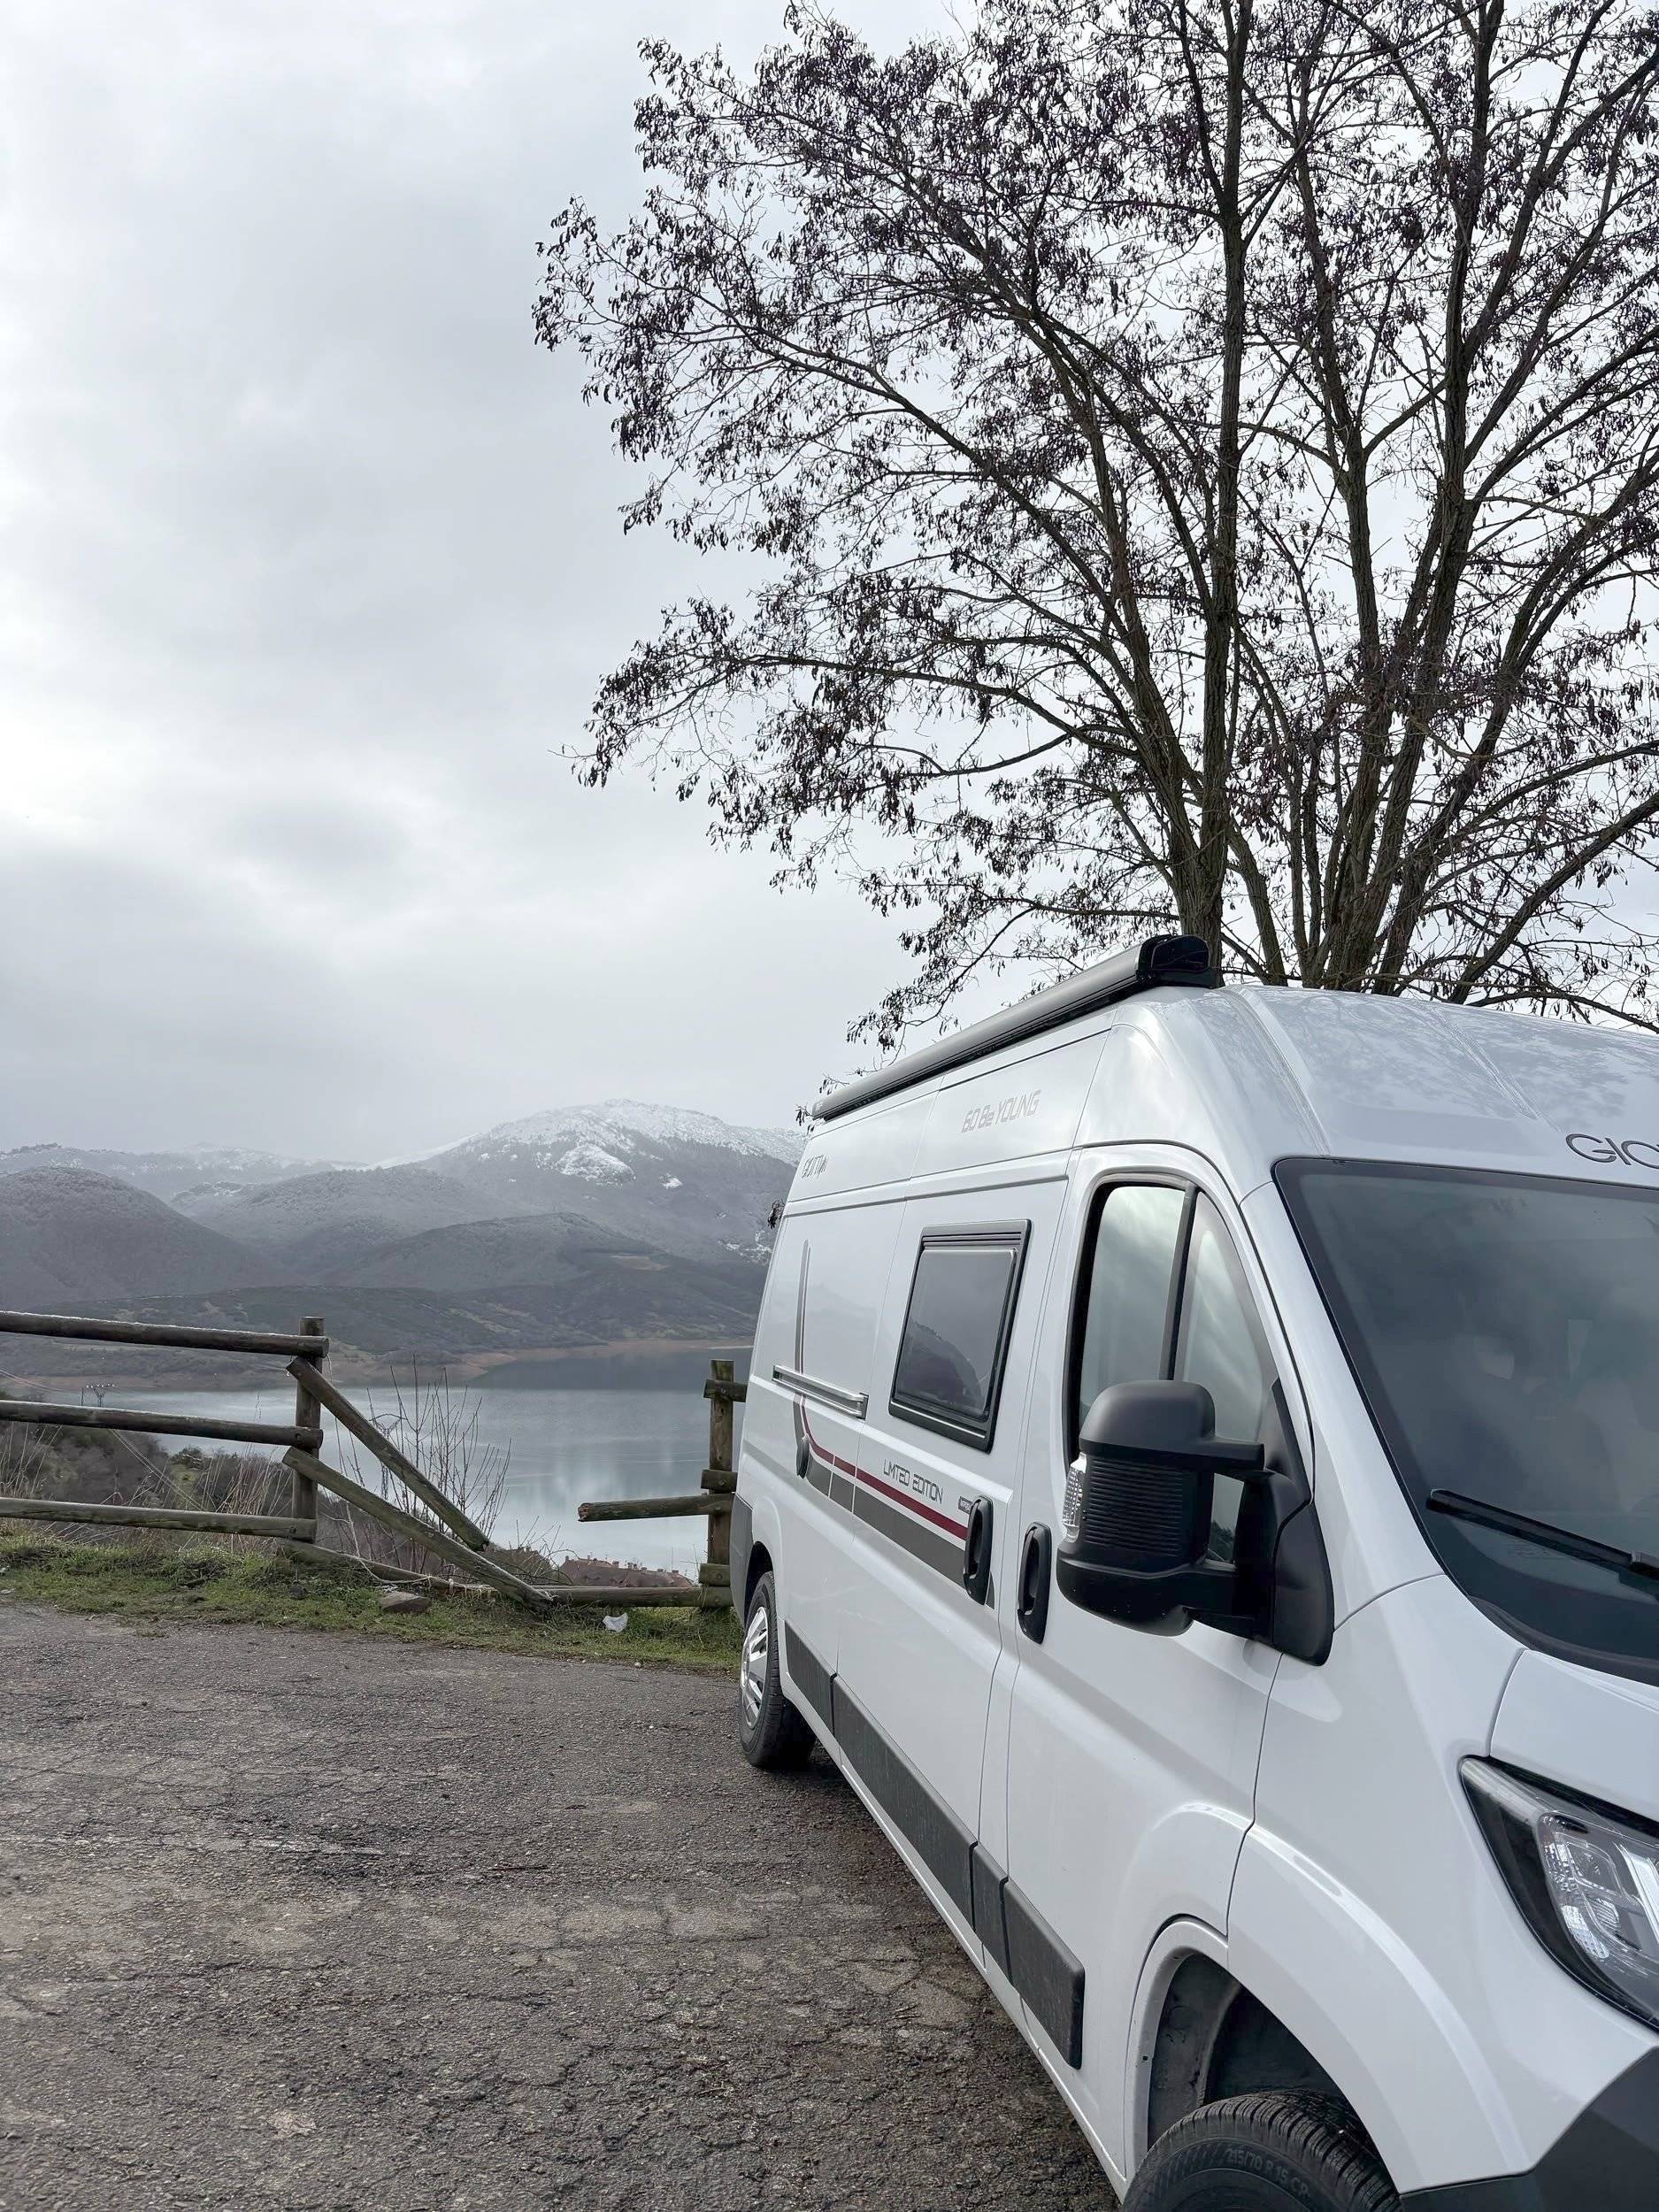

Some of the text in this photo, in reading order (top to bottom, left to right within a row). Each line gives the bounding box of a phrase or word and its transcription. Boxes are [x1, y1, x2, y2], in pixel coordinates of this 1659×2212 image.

[995, 1090, 1041, 1125] YOUNG
[1565, 1133, 1659, 1169] GIO
[913, 1473, 943, 1505] EDITION
